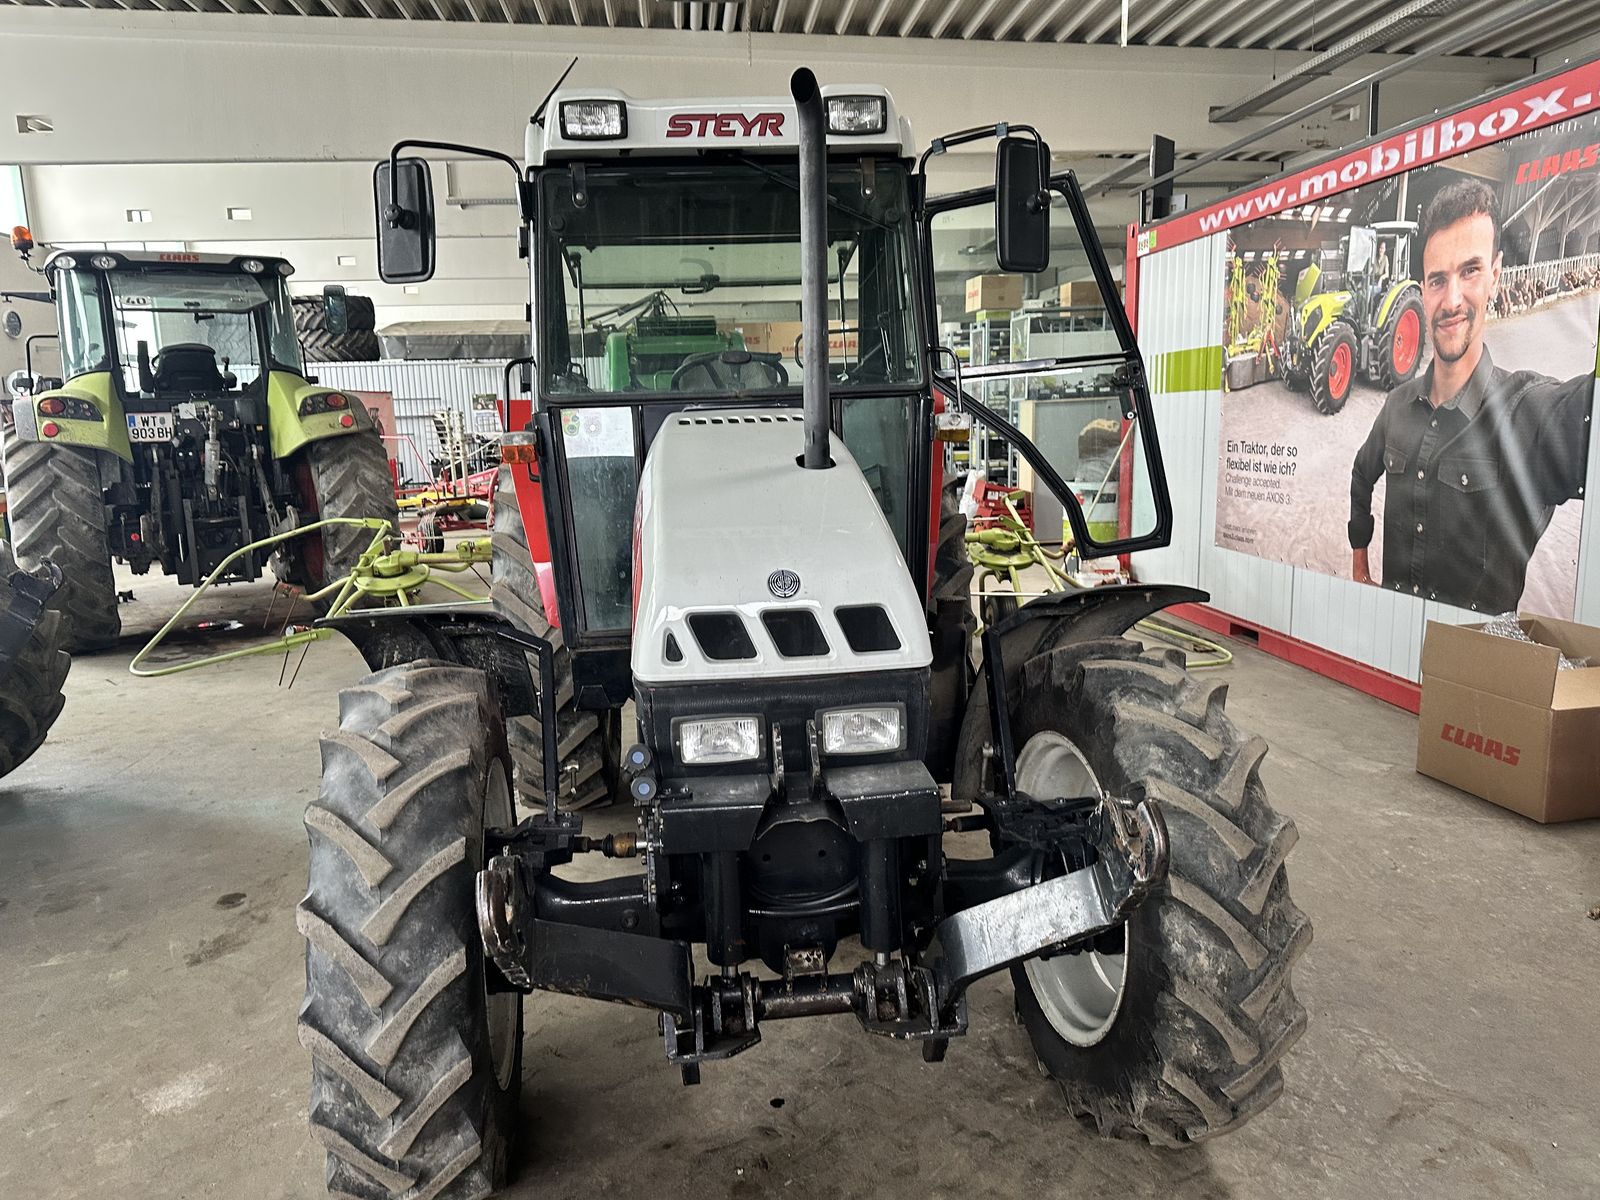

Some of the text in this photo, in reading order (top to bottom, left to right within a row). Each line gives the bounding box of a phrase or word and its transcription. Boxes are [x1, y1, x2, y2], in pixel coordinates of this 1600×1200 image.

[665, 113, 785, 137] STEYR
[1199, 86, 1600, 233] www.mobilbox.
[1515, 143, 1600, 185] CLAAS
[140, 415, 157, 427] WT
[132, 427, 173, 439] 903 BH
[1227, 440, 1298, 457] Ein Traktor, der so
[1226, 457, 1297, 476] flexibel ist wie ich?
[1440, 723, 1521, 767] CLAAS
